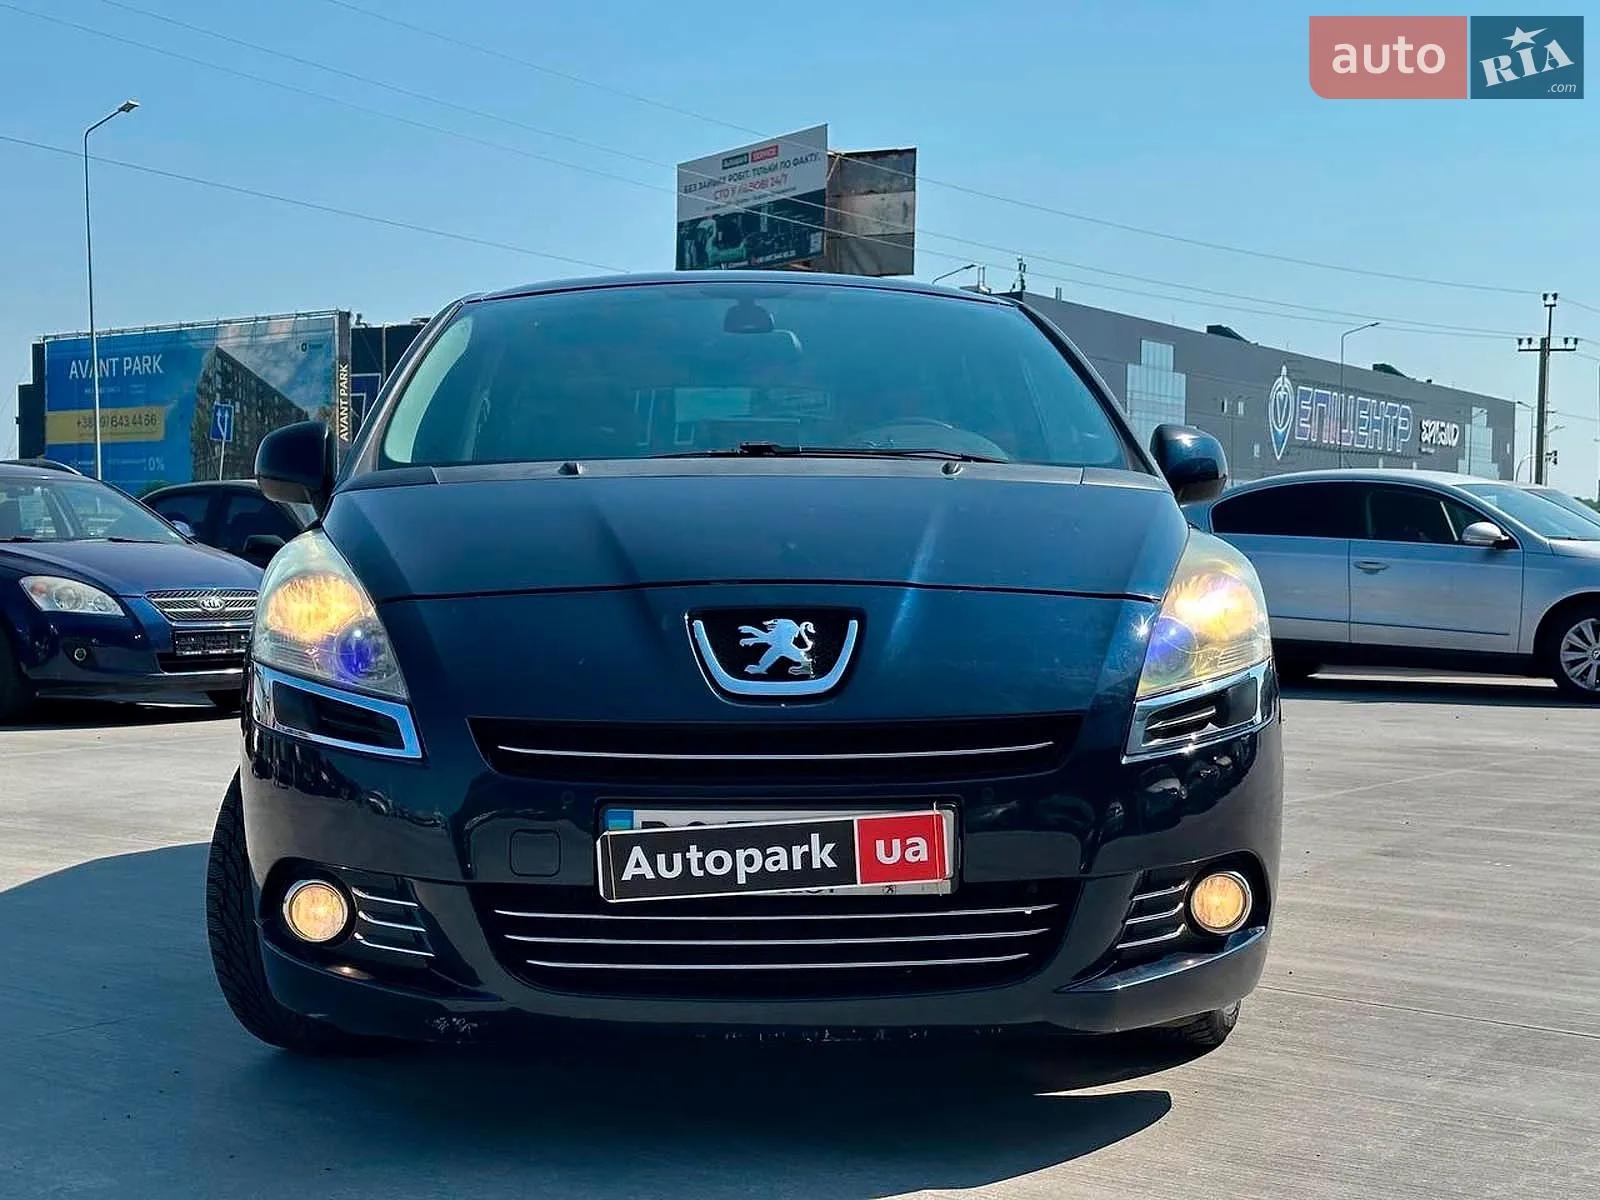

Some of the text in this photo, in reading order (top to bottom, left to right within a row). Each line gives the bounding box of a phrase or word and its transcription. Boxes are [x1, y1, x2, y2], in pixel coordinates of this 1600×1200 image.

[69, 354, 164, 379] AVANT PARK
[339, 362, 349, 442] AVANT PARK
[1294, 385, 1413, 453] ЕПІЦЕНТР
[621, 833, 929, 884] Autopark ua
